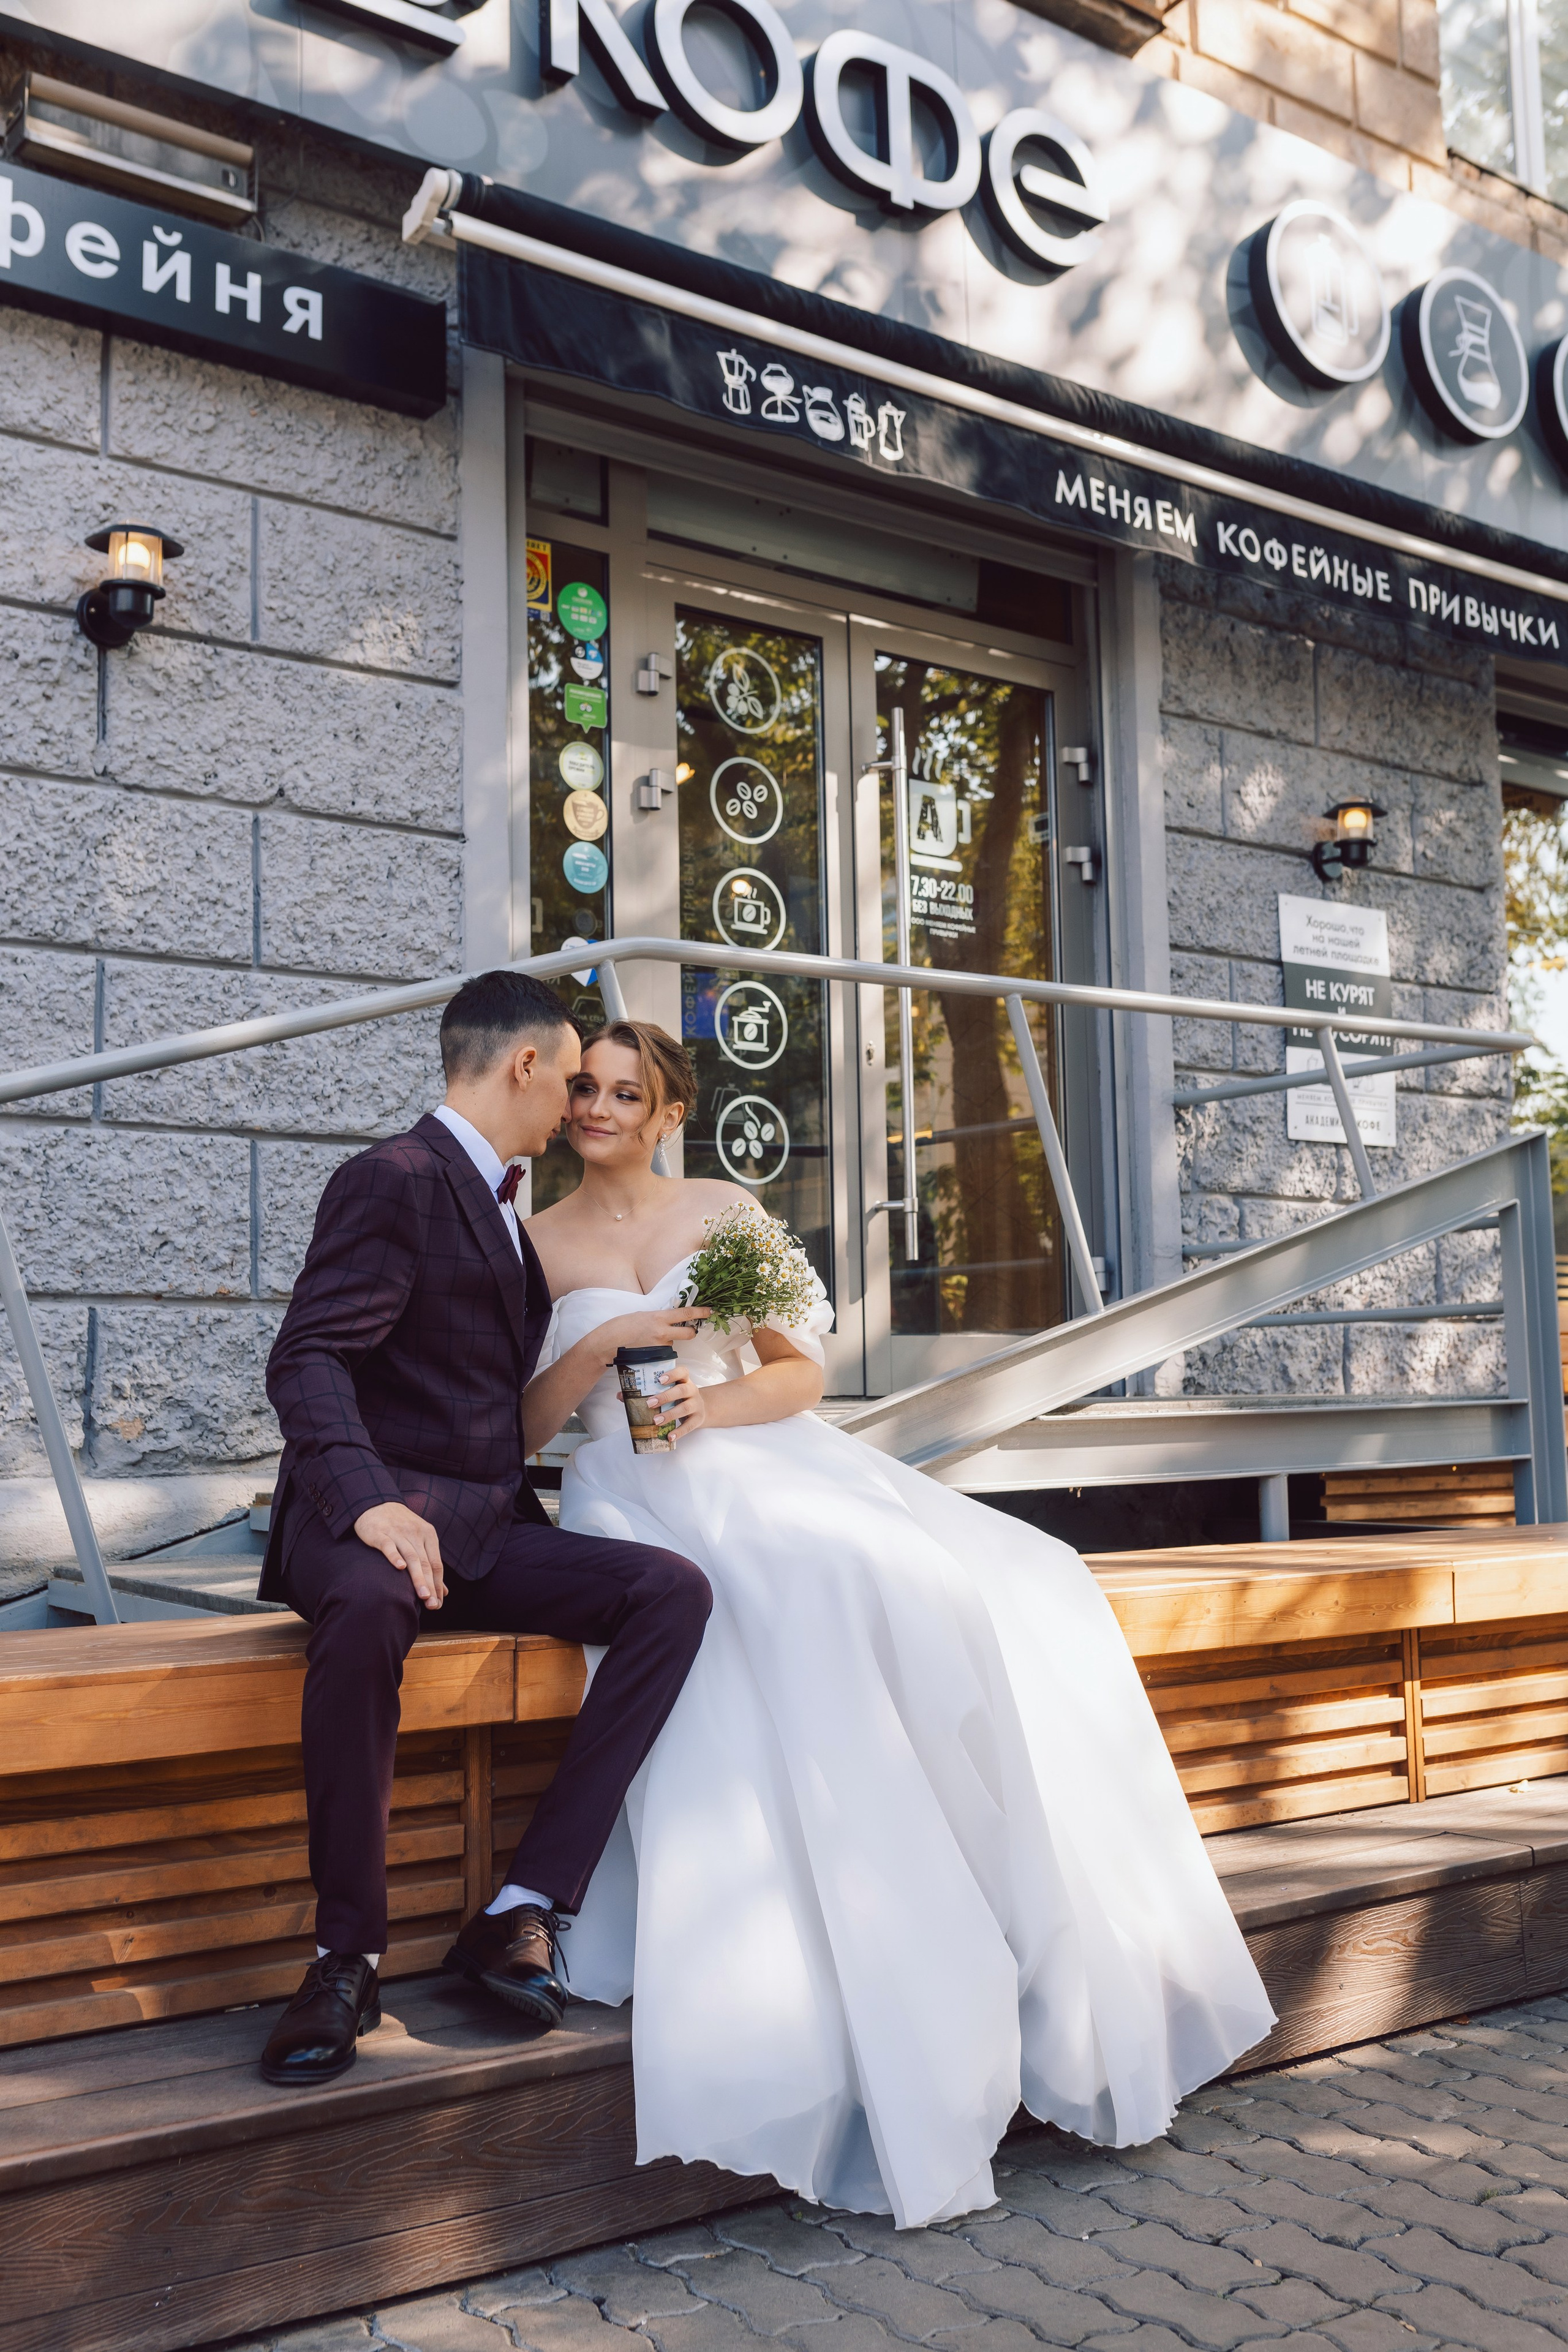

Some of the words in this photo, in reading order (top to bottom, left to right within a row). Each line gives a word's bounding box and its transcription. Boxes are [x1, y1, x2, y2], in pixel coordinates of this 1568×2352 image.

[1054, 470, 1198, 547] МЕНЯЕМ
[1216, 521, 1393, 603] КОФЕЙНЫЕ
[1408, 578, 1561, 650] ПРИВЫЧКИ
[910, 875, 974, 905] 7.30-22.00
[912, 899, 928, 914] БЕЗ
[929, 901, 974, 921] ВЫХОДНЫХ
[1312, 935, 1324, 944] на
[1328, 937, 1360, 948] нашей
[1293, 944, 1328, 957] летней
[1331, 951, 1379, 966] площадке
[1305, 978, 1327, 1000] НЕ
[1329, 981, 1375, 1006] КУРЯТ
